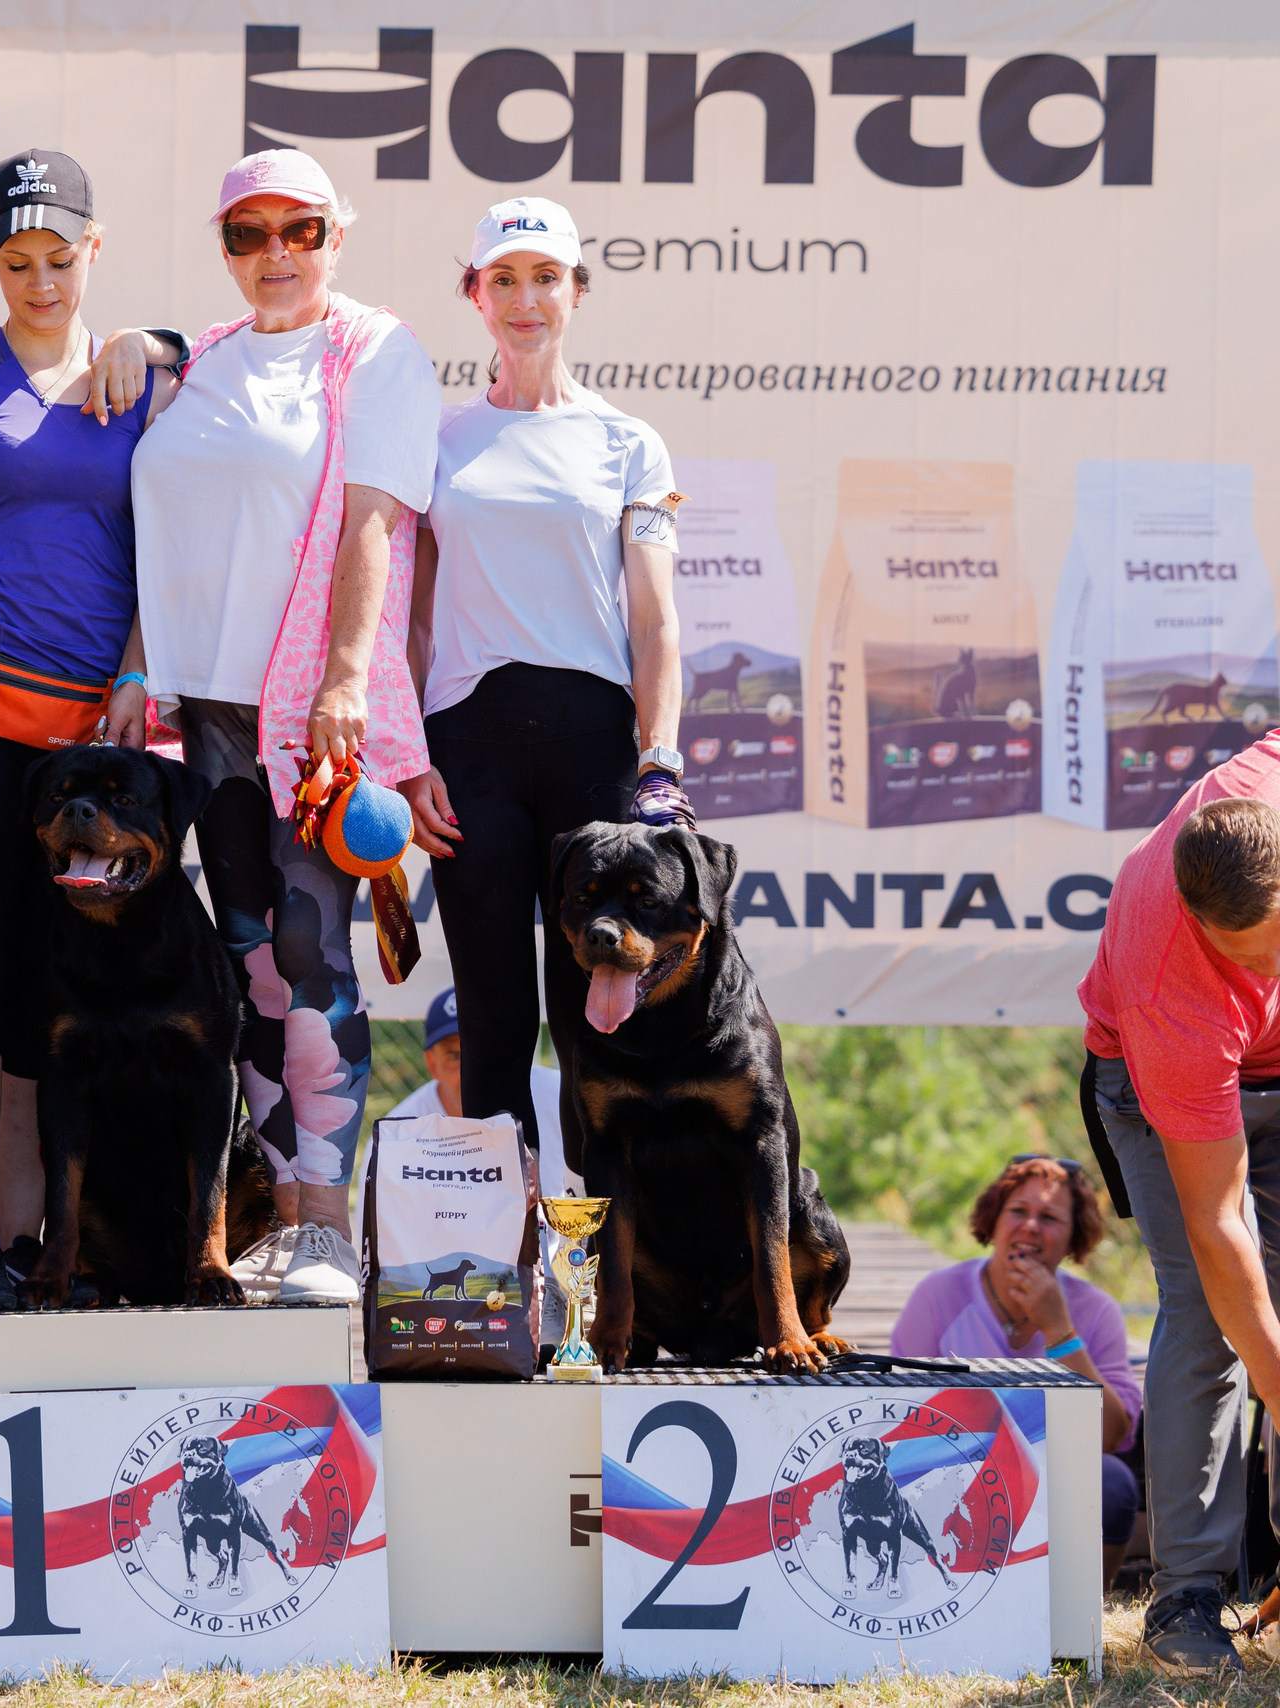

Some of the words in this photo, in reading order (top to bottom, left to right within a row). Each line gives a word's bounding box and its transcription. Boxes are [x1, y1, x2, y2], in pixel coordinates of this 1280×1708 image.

[243, 22, 1158, 188] Hanta
[7, 180, 58, 197] adidas
[501, 218, 549, 233] FILA
[952, 363, 1168, 394] питания
[674, 554, 763, 578] anta
[886, 557, 999, 580] Hanta
[1126, 560, 1238, 583] Hanta
[827, 661, 845, 804] Hanta
[1066, 663, 1084, 806] Hanta
[733, 870, 1116, 932] ANTA.C
[461, 1146, 483, 1157] рисом
[402, 1165, 503, 1183] Hanta
[435, 1211, 468, 1219] PUPPY
[113, 1406, 200, 1577] РОТВЕЙЛЕР
[219, 1401, 299, 1437] КЛУБ
[305, 1441, 347, 1571] РОССИИ
[773, 1406, 863, 1575] РОТВЕЙЛЕР
[881, 1403, 962, 1442] КЛУБ
[968, 1447, 1009, 1578] РОССИИ
[621, 1400, 751, 1631] 2
[173, 1594, 301, 1633] РКФ-НКПР
[831, 1600, 960, 1636] РКФ-НКПР
